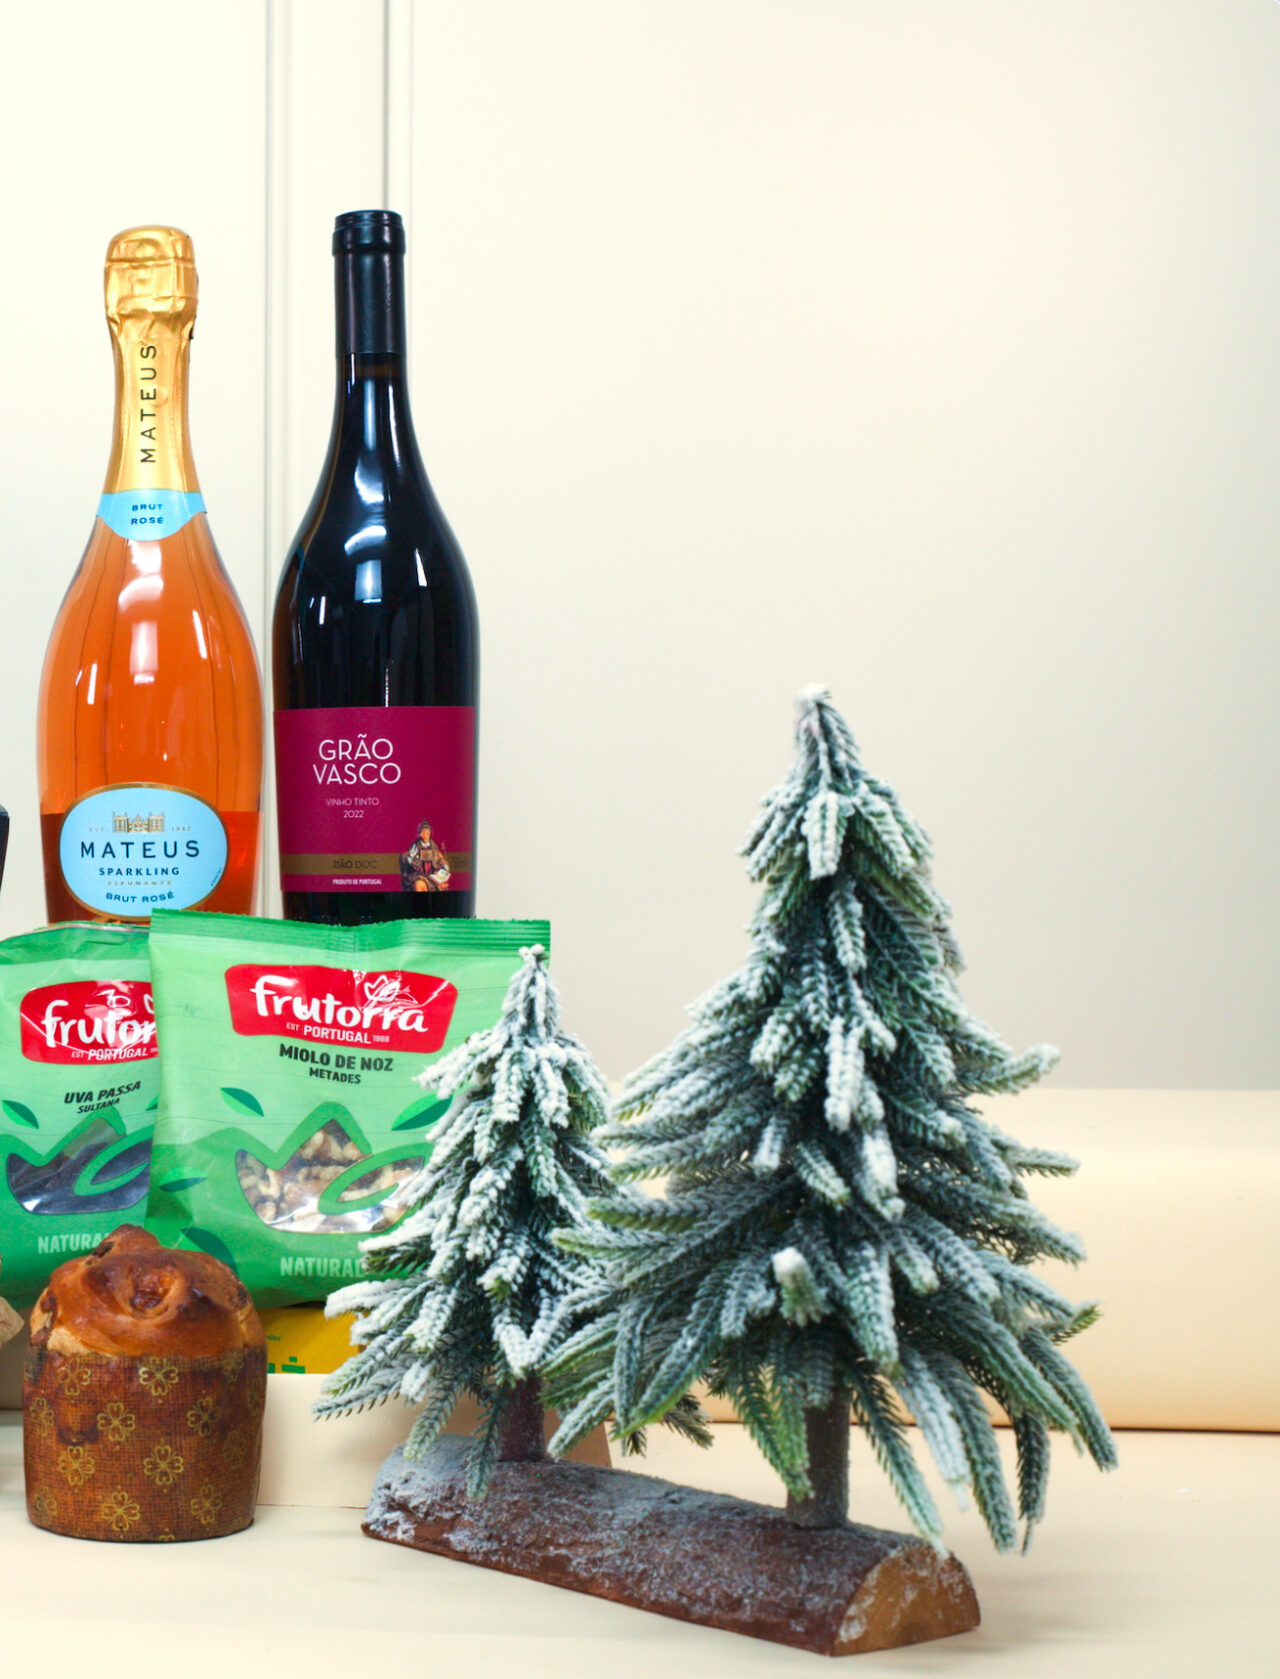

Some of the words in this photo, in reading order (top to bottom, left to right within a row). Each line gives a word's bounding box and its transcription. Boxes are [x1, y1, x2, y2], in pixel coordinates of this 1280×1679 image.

[140, 345, 157, 463] MATEUS
[131, 503, 163, 511] BRUT
[131, 516, 164, 525] ROSÉ
[319, 733, 394, 761] GRÃO
[312, 762, 402, 785] VASCO
[326, 798, 352, 806] VINHO
[354, 797, 380, 806] TINTO
[343, 810, 364, 818] 2022
[81, 840, 200, 859] MATEUS
[99, 866, 180, 876] SPARKLING
[105, 893, 137, 903] BRUT
[142, 891, 174, 903] ROSÉ
[249, 975, 429, 1033] frutorra
[286, 1022, 300, 1031] EST
[303, 1024, 372, 1044] PORTUGAL
[88, 1047, 148, 1060] PORTUGAL
[279, 1043, 330, 1066] MIOLO
[335, 1054, 356, 1070] DE
[360, 1056, 394, 1072] NOZ
[309, 1067, 361, 1084] METADES
[64, 1091, 93, 1104] UVA
[97, 1080, 141, 1100] PASSA
[77, 1097, 120, 1114] SULTANA
[280, 1256, 365, 1278] NATURAL
